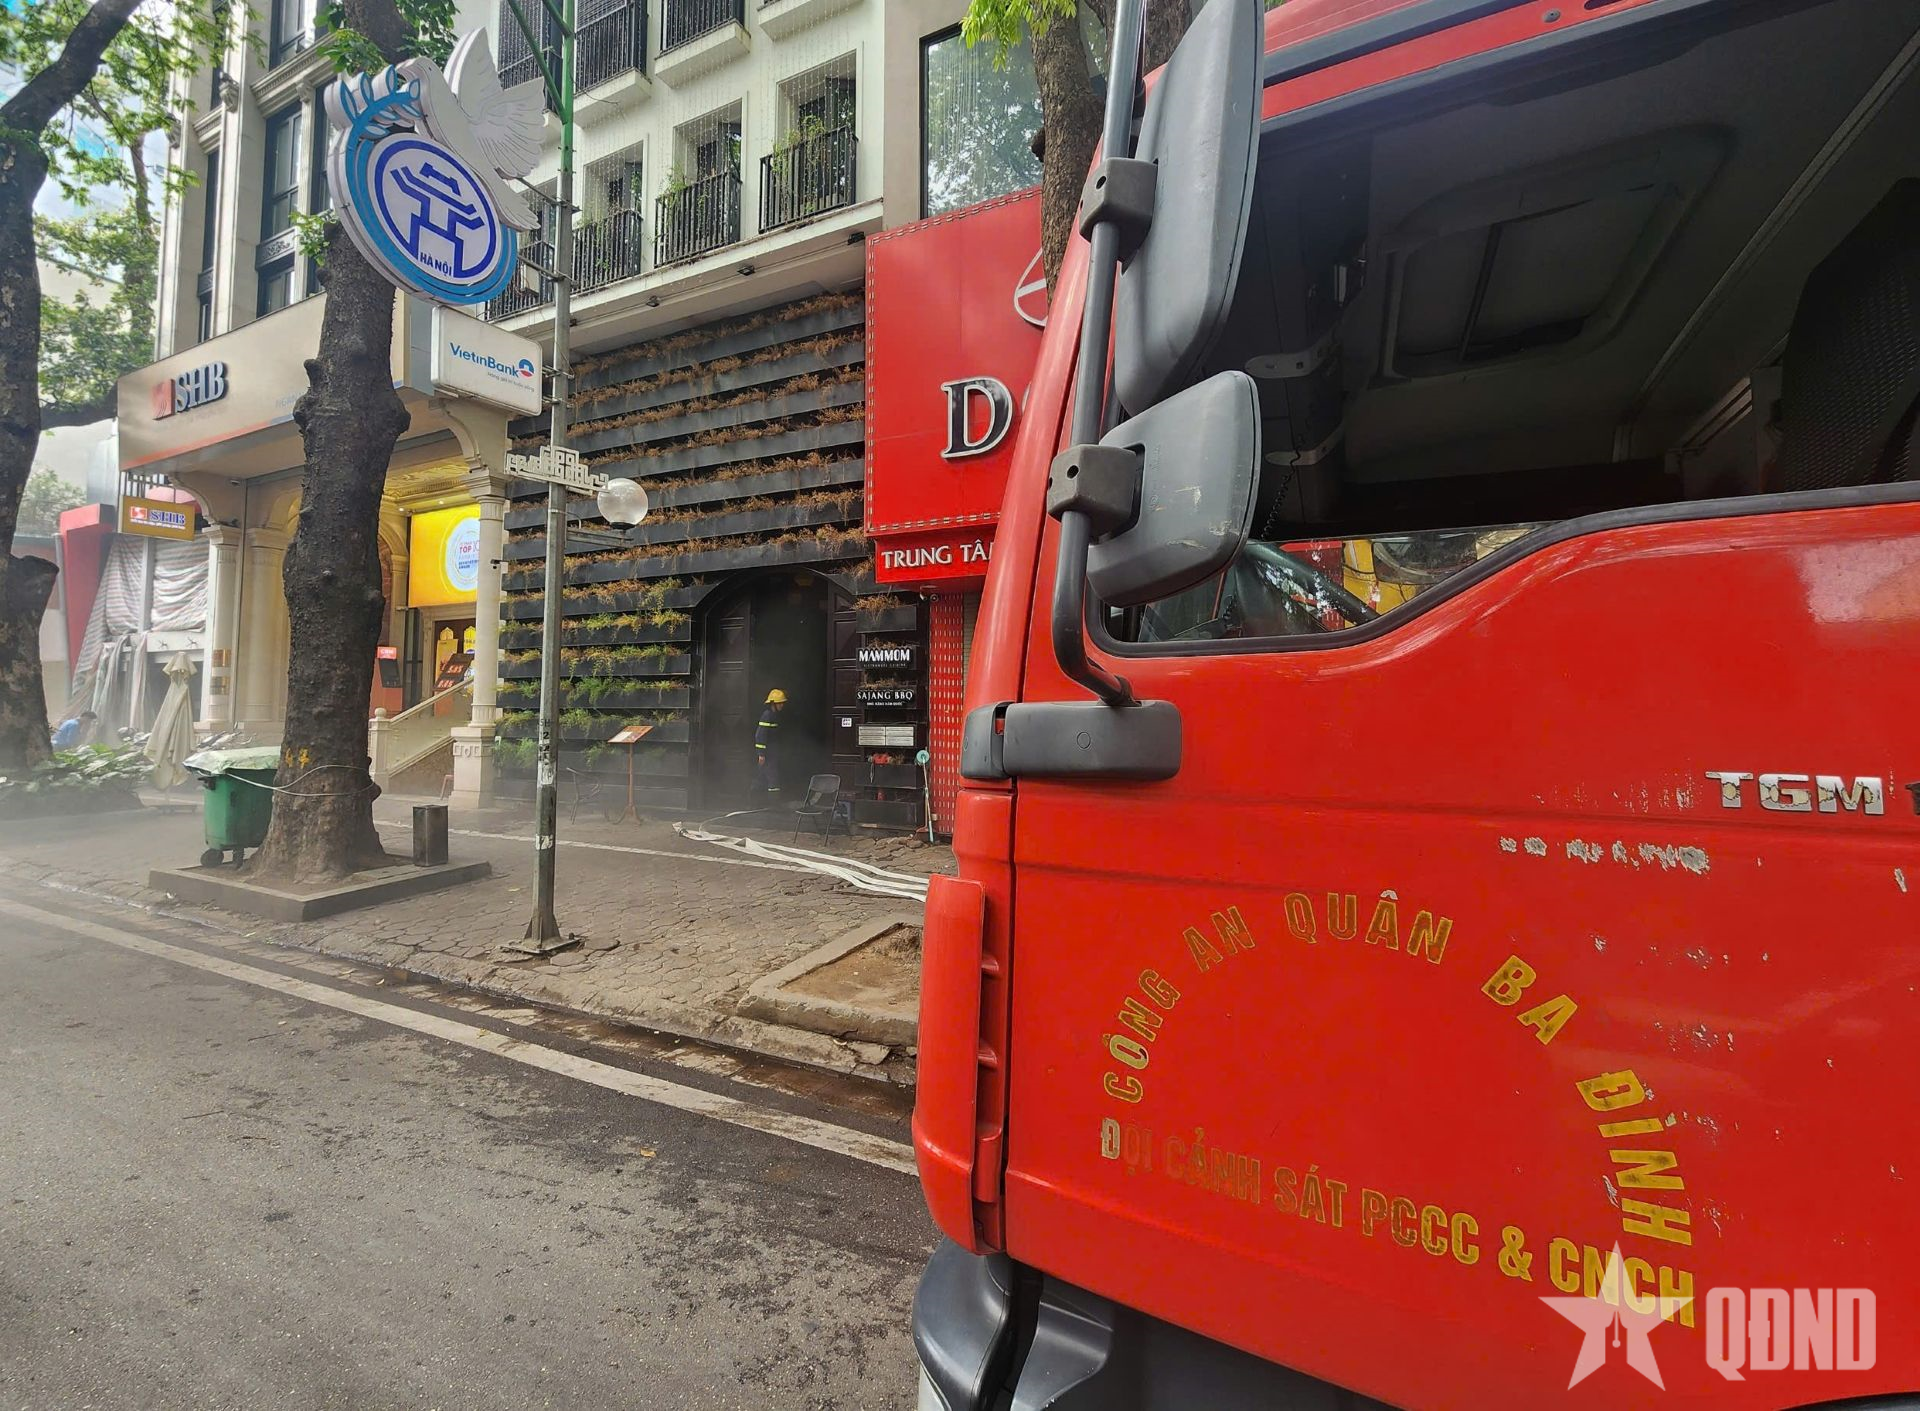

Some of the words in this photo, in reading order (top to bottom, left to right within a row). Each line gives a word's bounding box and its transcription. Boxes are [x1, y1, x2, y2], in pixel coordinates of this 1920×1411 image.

[420, 251, 434, 268] HÀ
[434, 259, 452, 277] NỘI
[449, 341, 520, 378] VietinBank
[174, 360, 229, 414] SHB
[941, 376, 1031, 460] D
[149, 509, 187, 526] SHB
[880, 545, 953, 569] TRUNG
[859, 649, 911, 662] MAMMOM
[857, 691, 891, 701] SAJANG
[894, 691, 913, 701] BBQ
[1705, 771, 1885, 816] TGM
[1102, 968, 1182, 1104] CÔNG
[1182, 905, 1257, 972] AN
[1283, 889, 1454, 965] QUÂN
[1480, 955, 1578, 1045] BA
[1163, 1126, 1261, 1205] CẢNH
[1273, 1163, 1349, 1228] SÁT
[1361, 1187, 1481, 1266] PCCC
[1498, 1224, 1534, 1283] &
[1548, 1236, 1696, 1329] CNCH
